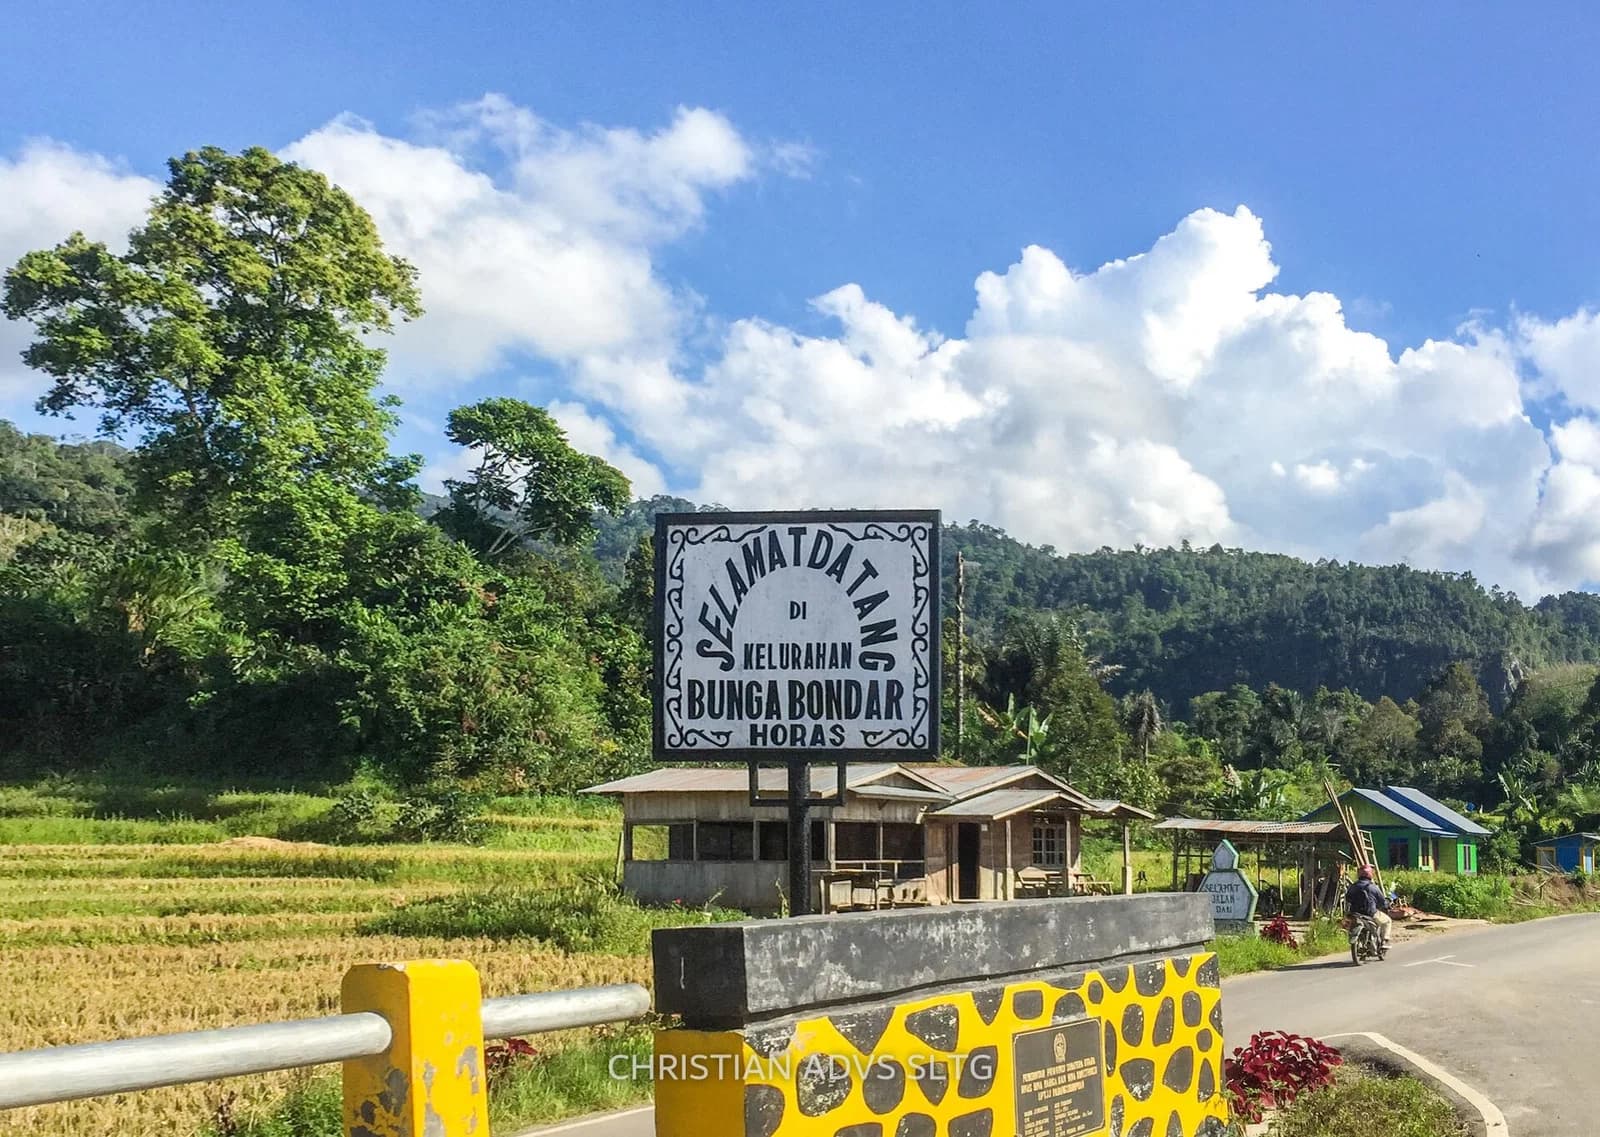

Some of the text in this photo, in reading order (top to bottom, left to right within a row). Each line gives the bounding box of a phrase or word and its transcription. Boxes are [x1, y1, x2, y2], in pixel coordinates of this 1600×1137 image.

[696, 527, 898, 672] SELAMAT DATANG
[789, 601, 807, 620] DI
[743, 642, 852, 670] KELURAHAN
[687, 679, 904, 721] BUNGA BONDAR
[750, 723, 846, 747] HORAS
